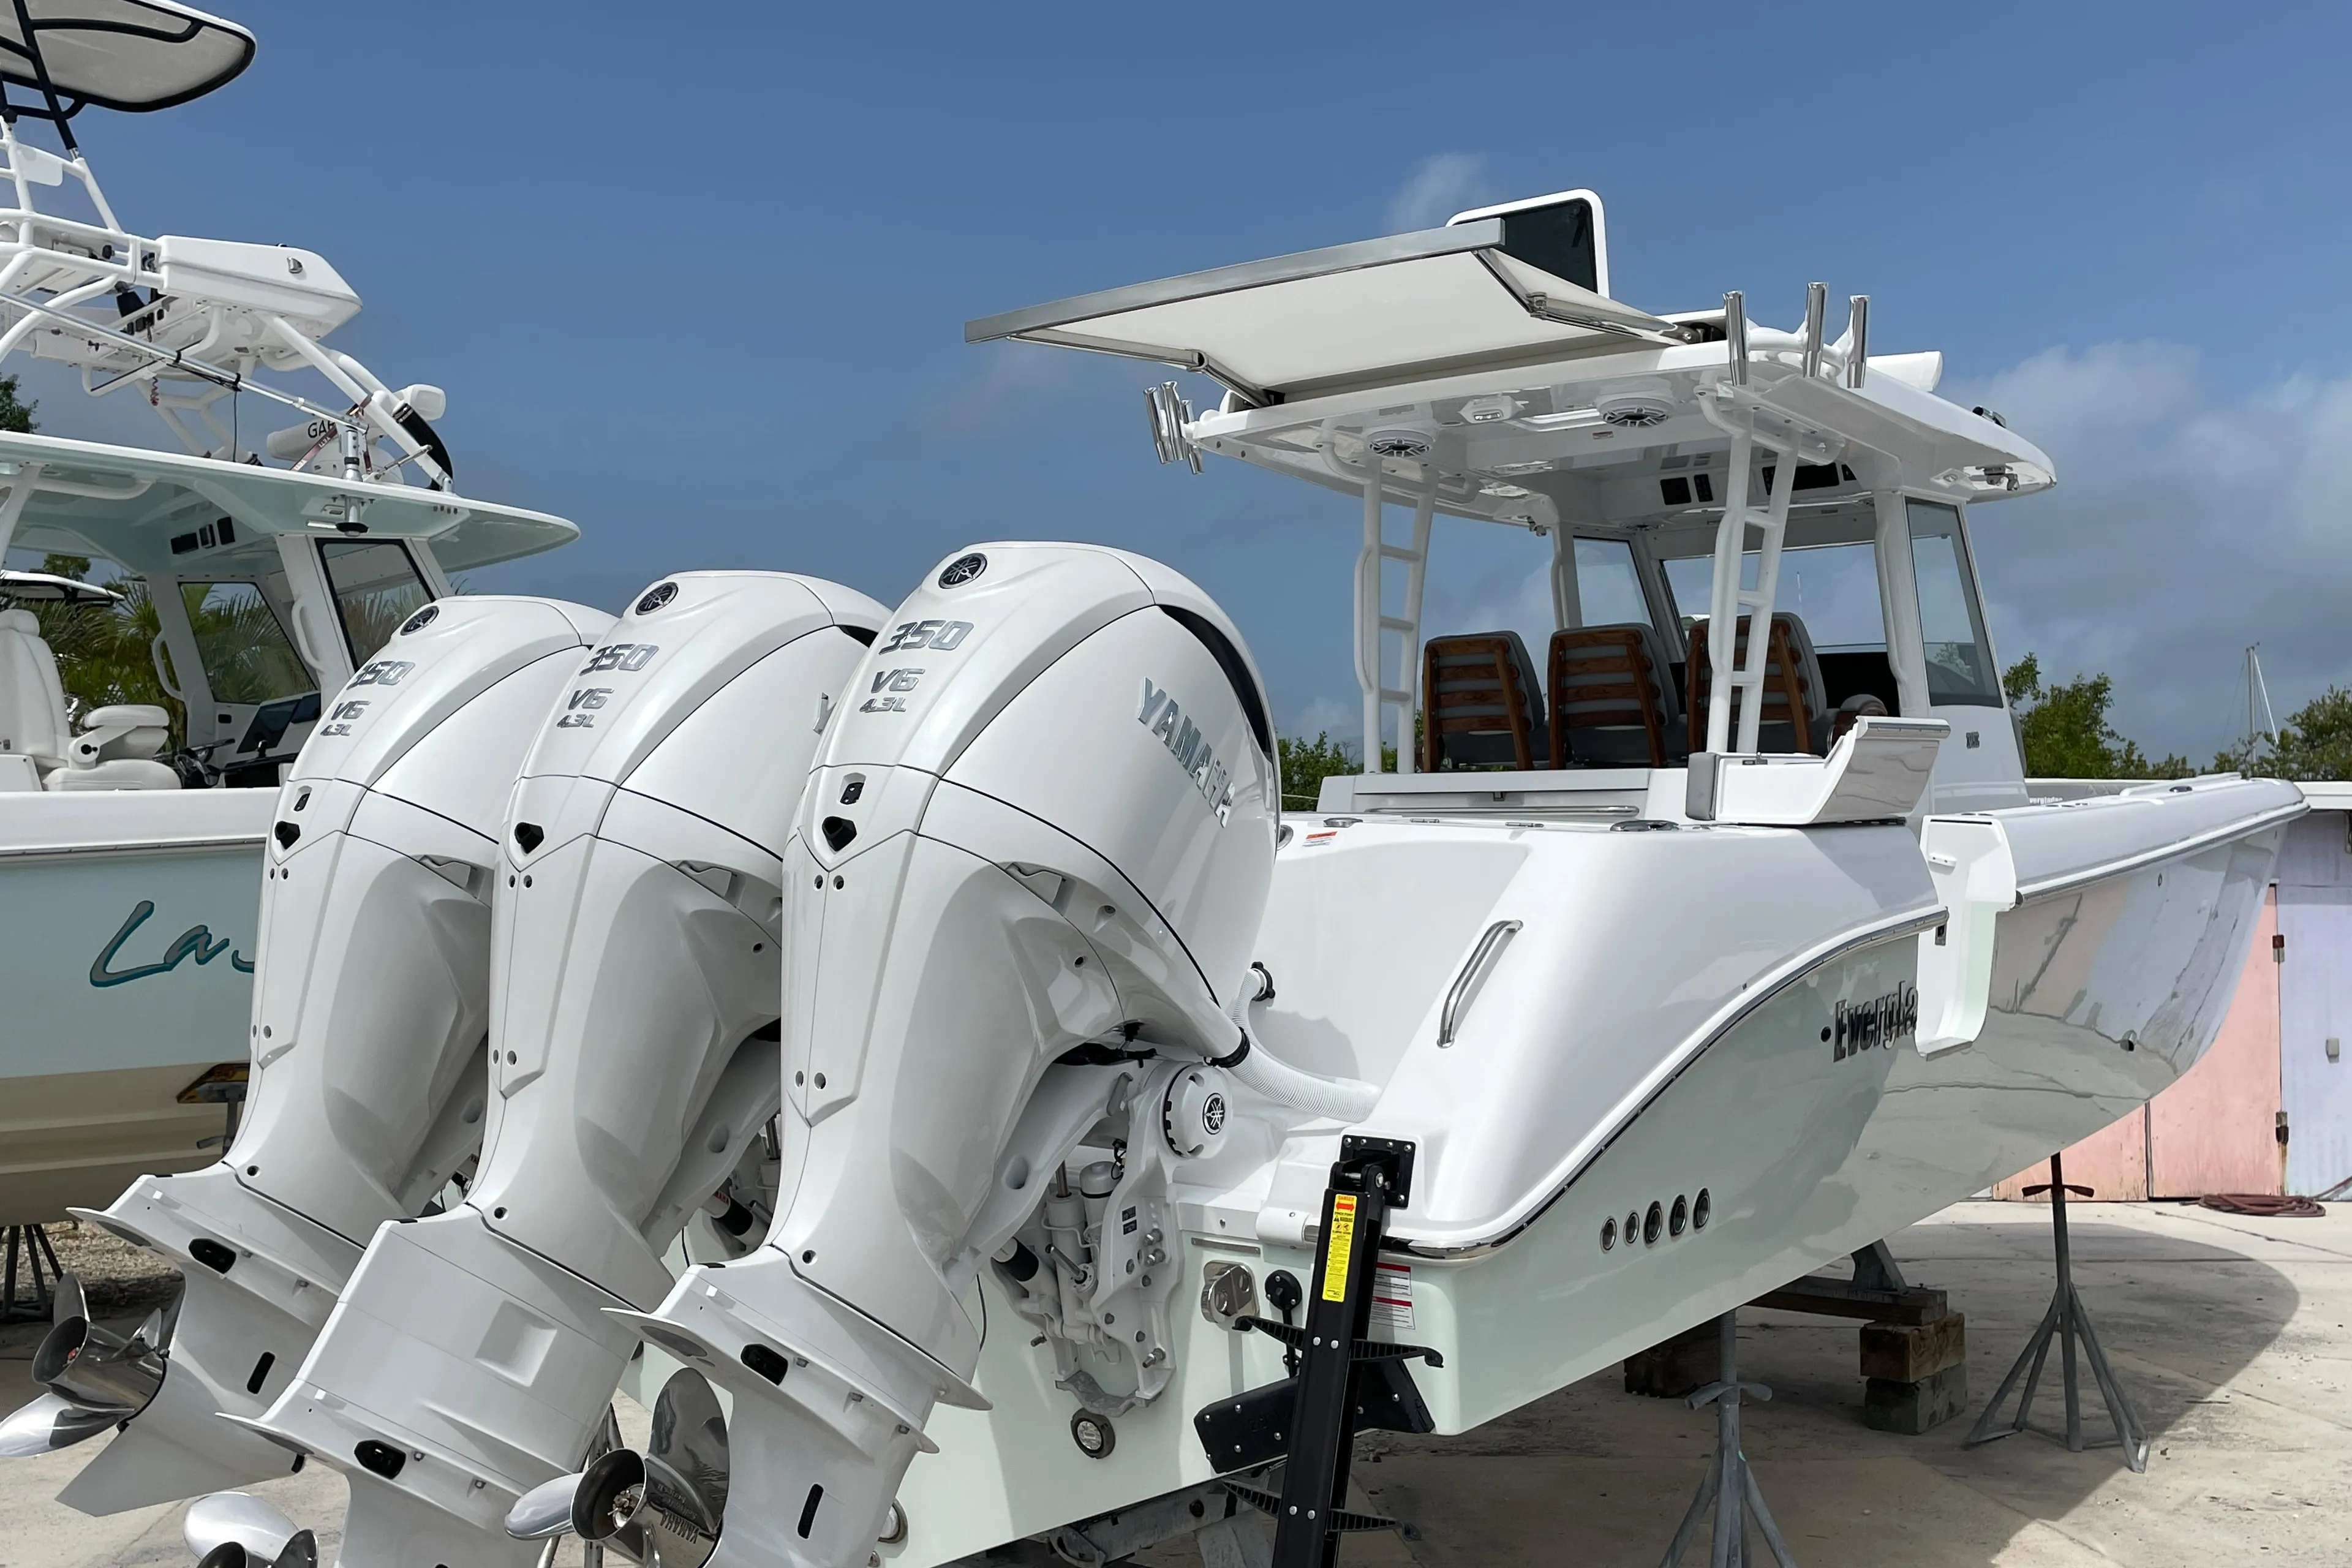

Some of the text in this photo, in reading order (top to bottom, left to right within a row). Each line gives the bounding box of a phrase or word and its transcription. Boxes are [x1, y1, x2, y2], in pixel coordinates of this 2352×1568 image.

[878, 620, 974, 655] 350
[579, 643, 660, 677] 350
[346, 660, 416, 690] 350
[871, 668, 925, 693] V6
[331, 700, 372, 721] V6
[568, 688, 615, 710] V6
[859, 696, 907, 713] 4.3L
[1137, 677, 1236, 828] YAMAHA
